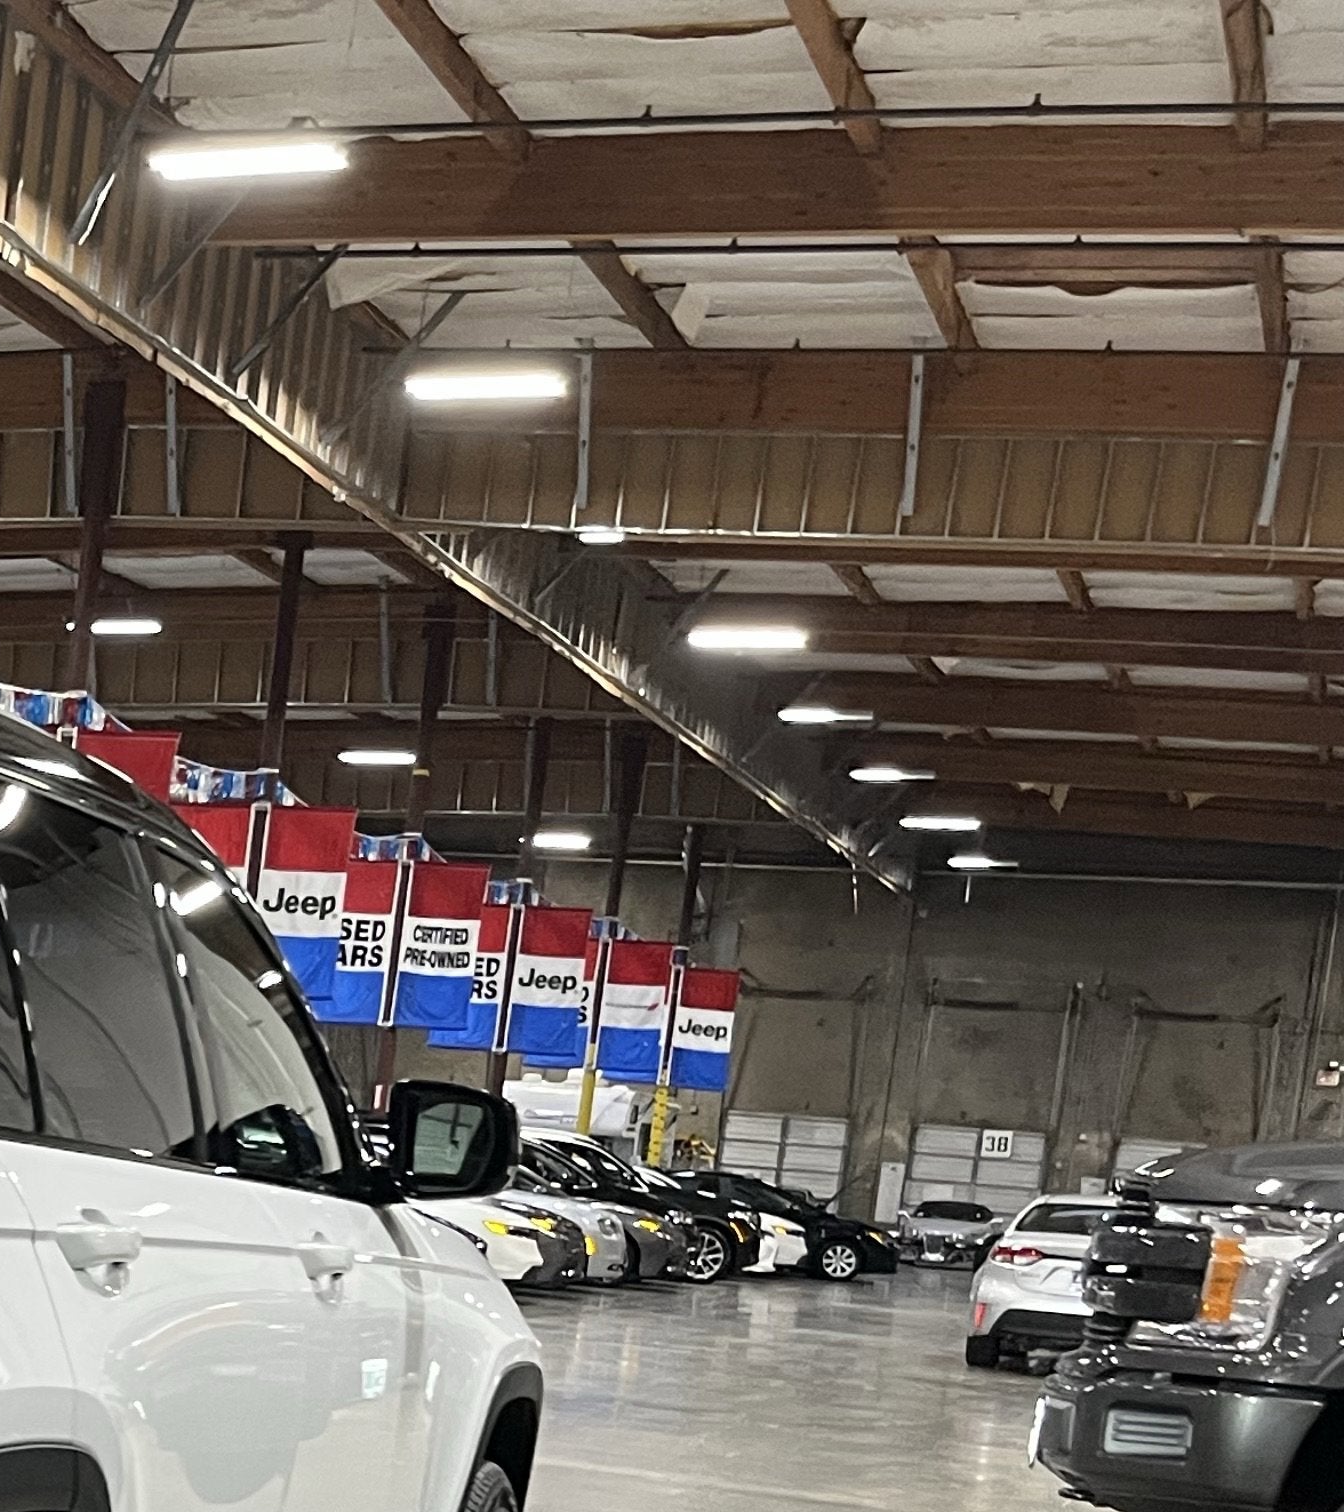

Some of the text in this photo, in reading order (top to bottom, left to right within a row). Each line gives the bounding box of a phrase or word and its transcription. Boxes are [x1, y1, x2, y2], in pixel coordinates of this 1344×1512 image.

[263, 887, 336, 920] Jeep
[340, 918, 386, 942] SED
[413, 924, 469, 946] CERTIFIED
[337, 945, 383, 967] ARS
[403, 947, 470, 969] PRE-OWNED
[475, 957, 500, 977] ED
[472, 980, 497, 1000] RS
[518, 968, 577, 994] Jeep
[678, 1018, 728, 1041] Jeep
[985, 1136, 1009, 1152] 38
